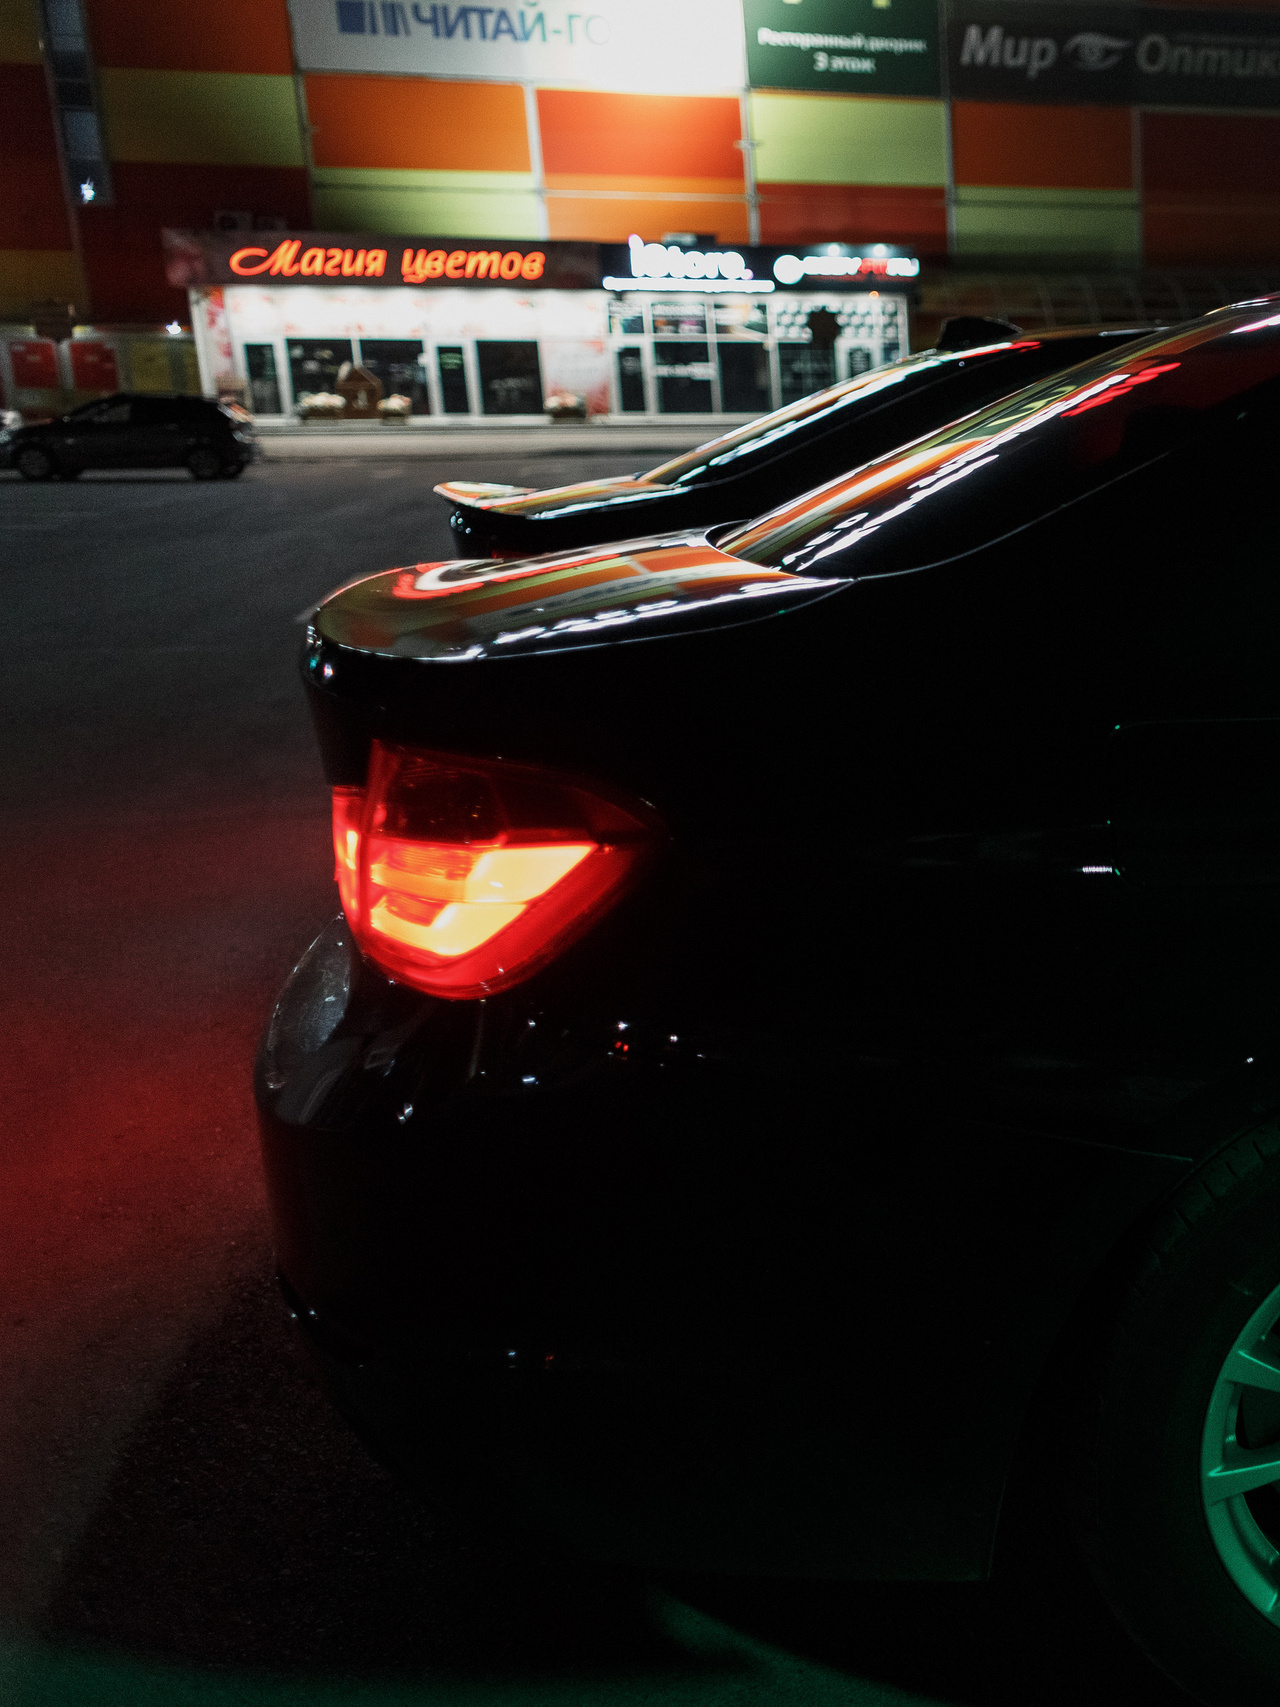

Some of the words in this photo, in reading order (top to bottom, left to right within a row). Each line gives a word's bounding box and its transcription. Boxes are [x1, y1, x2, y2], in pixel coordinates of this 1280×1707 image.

[813, 51, 829, 72] 3
[960, 24, 1058, 79] Мир
[229, 239, 387, 277] Магия
[400, 248, 546, 284] цветов
